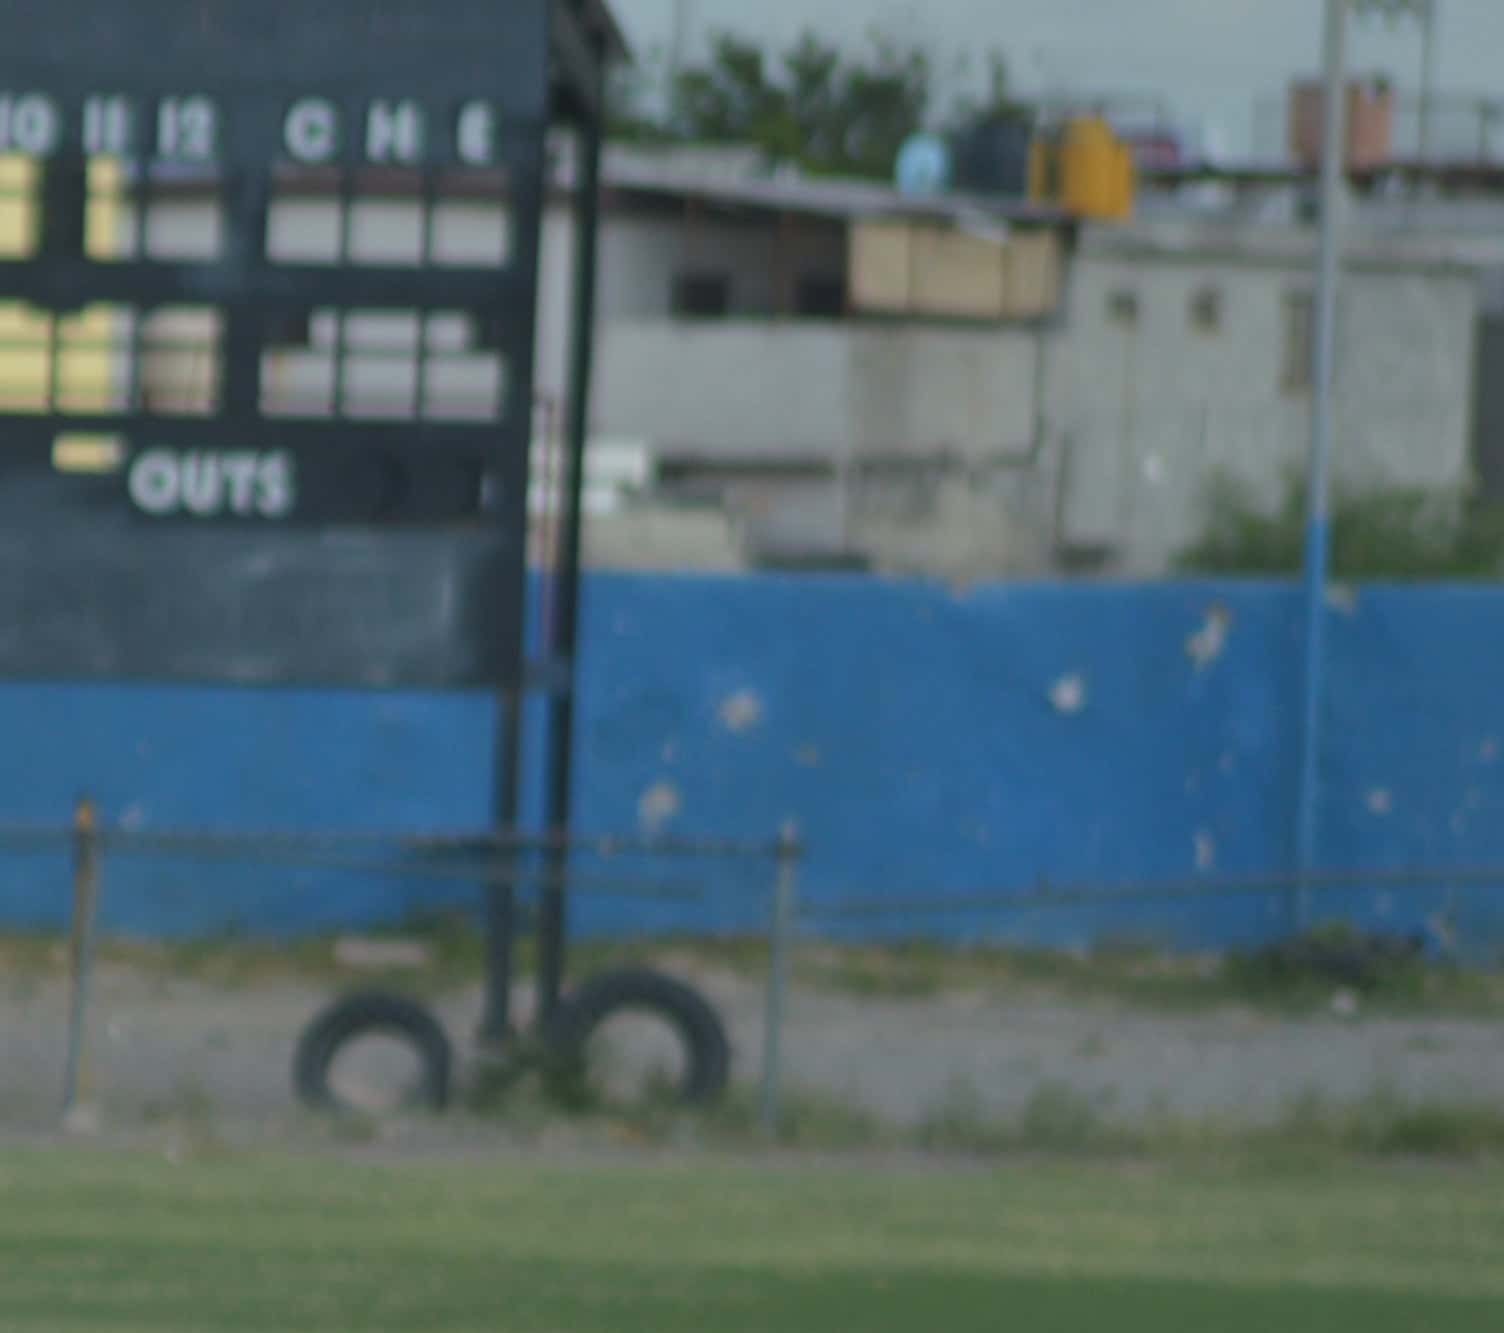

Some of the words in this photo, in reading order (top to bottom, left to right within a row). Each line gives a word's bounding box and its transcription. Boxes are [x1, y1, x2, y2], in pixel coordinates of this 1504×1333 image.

[83, 94, 128, 152] 11
[157, 96, 213, 159] 12
[285, 99, 335, 161] C
[367, 100, 421, 163] H
[129, 449, 291, 516] OUTS
